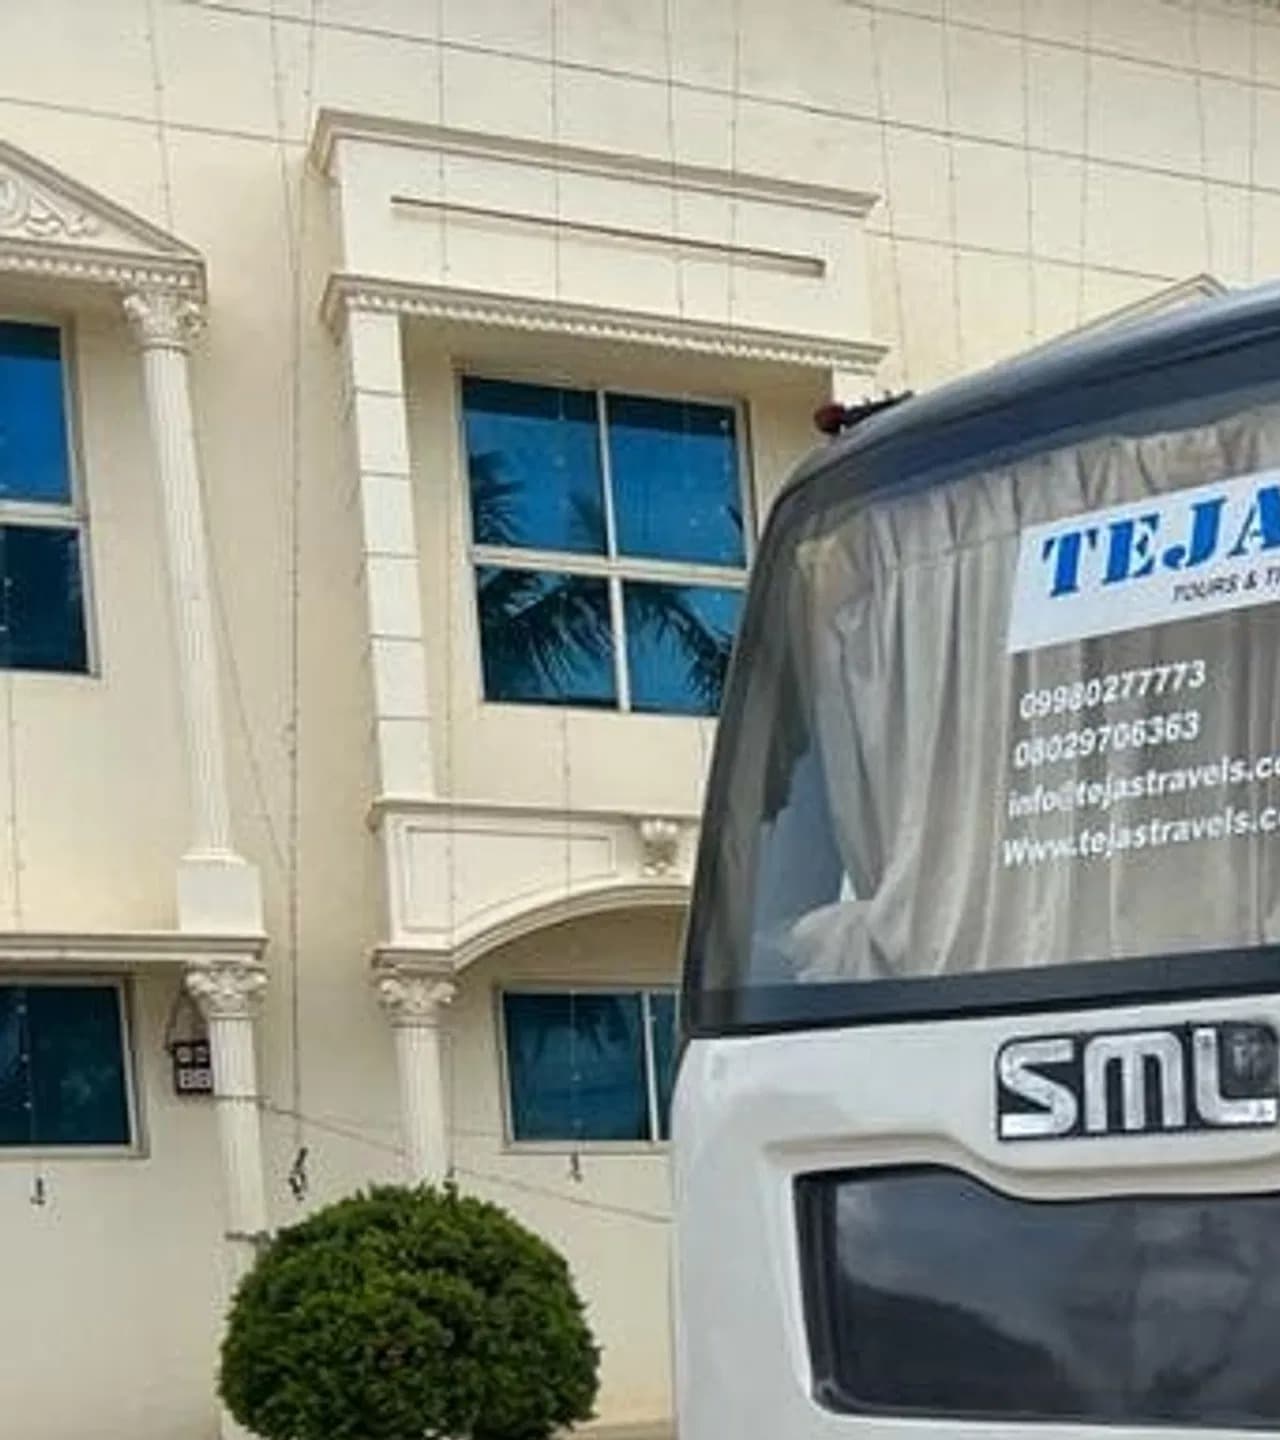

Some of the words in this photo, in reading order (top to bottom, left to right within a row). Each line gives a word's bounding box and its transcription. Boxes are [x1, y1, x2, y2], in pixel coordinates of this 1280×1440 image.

[1171, 573, 1238, 602] TOURS
[1243, 569, 1258, 591] &
[1000, 1027, 1278, 1138] SML
